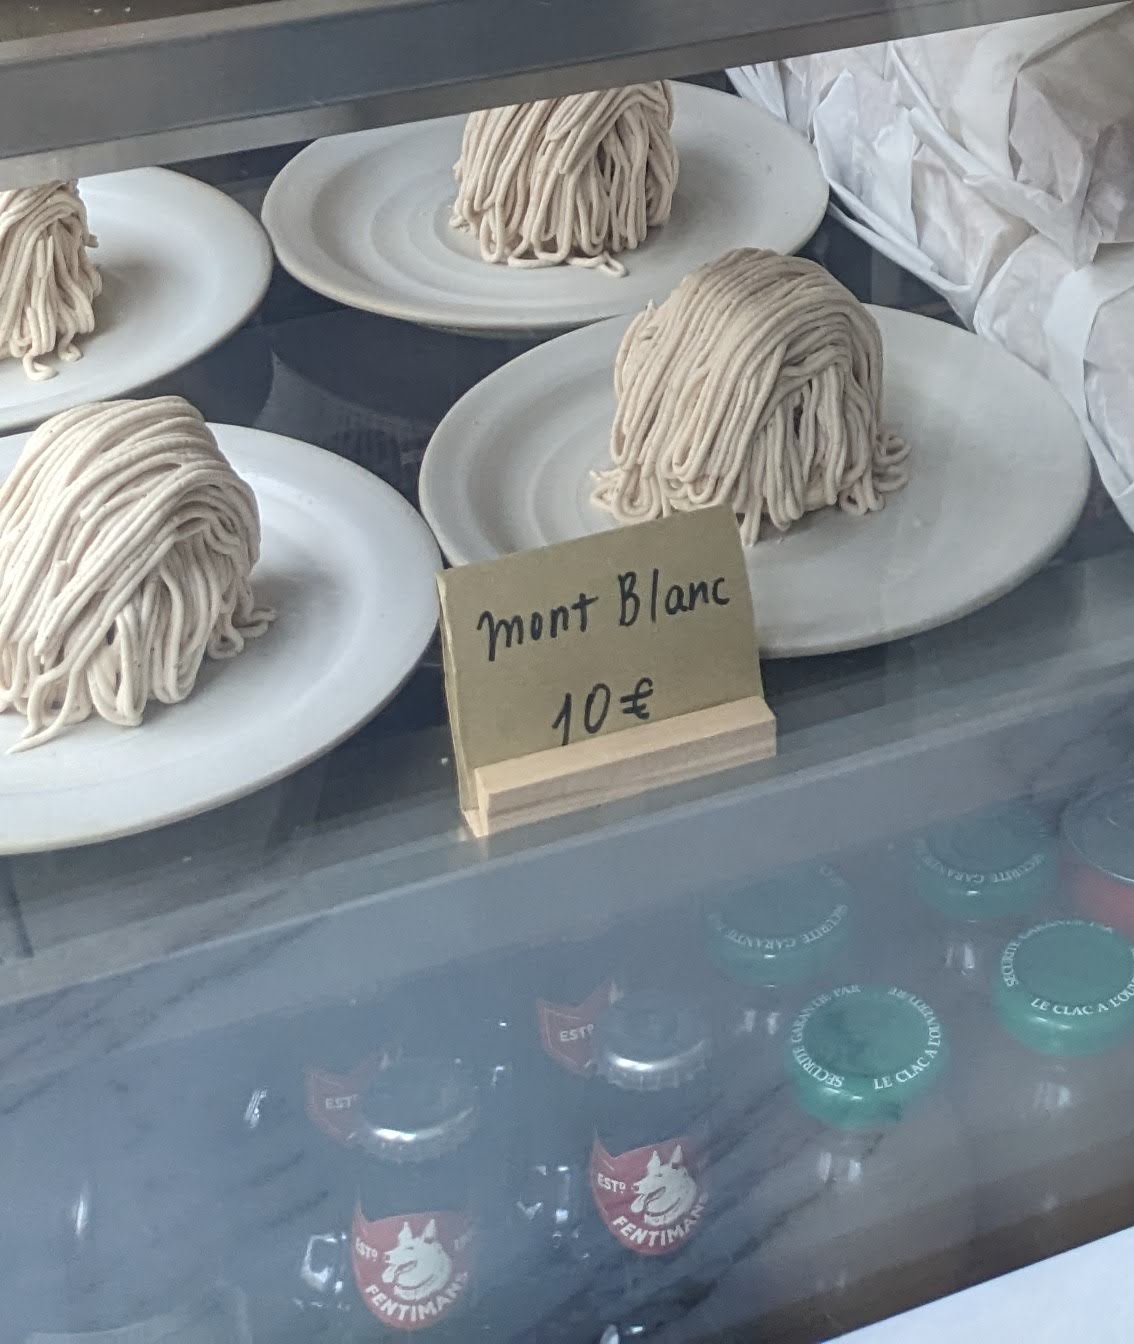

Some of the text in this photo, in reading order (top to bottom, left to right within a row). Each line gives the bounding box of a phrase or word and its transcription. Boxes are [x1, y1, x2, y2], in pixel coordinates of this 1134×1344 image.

[617, 568, 731, 628] Blanc
[1030, 997, 1051, 1011] LE
[1052, 1004, 1095, 1016] CLAC
[873, 1075, 894, 1090] LE
[895, 1056, 931, 1084] CLAC
